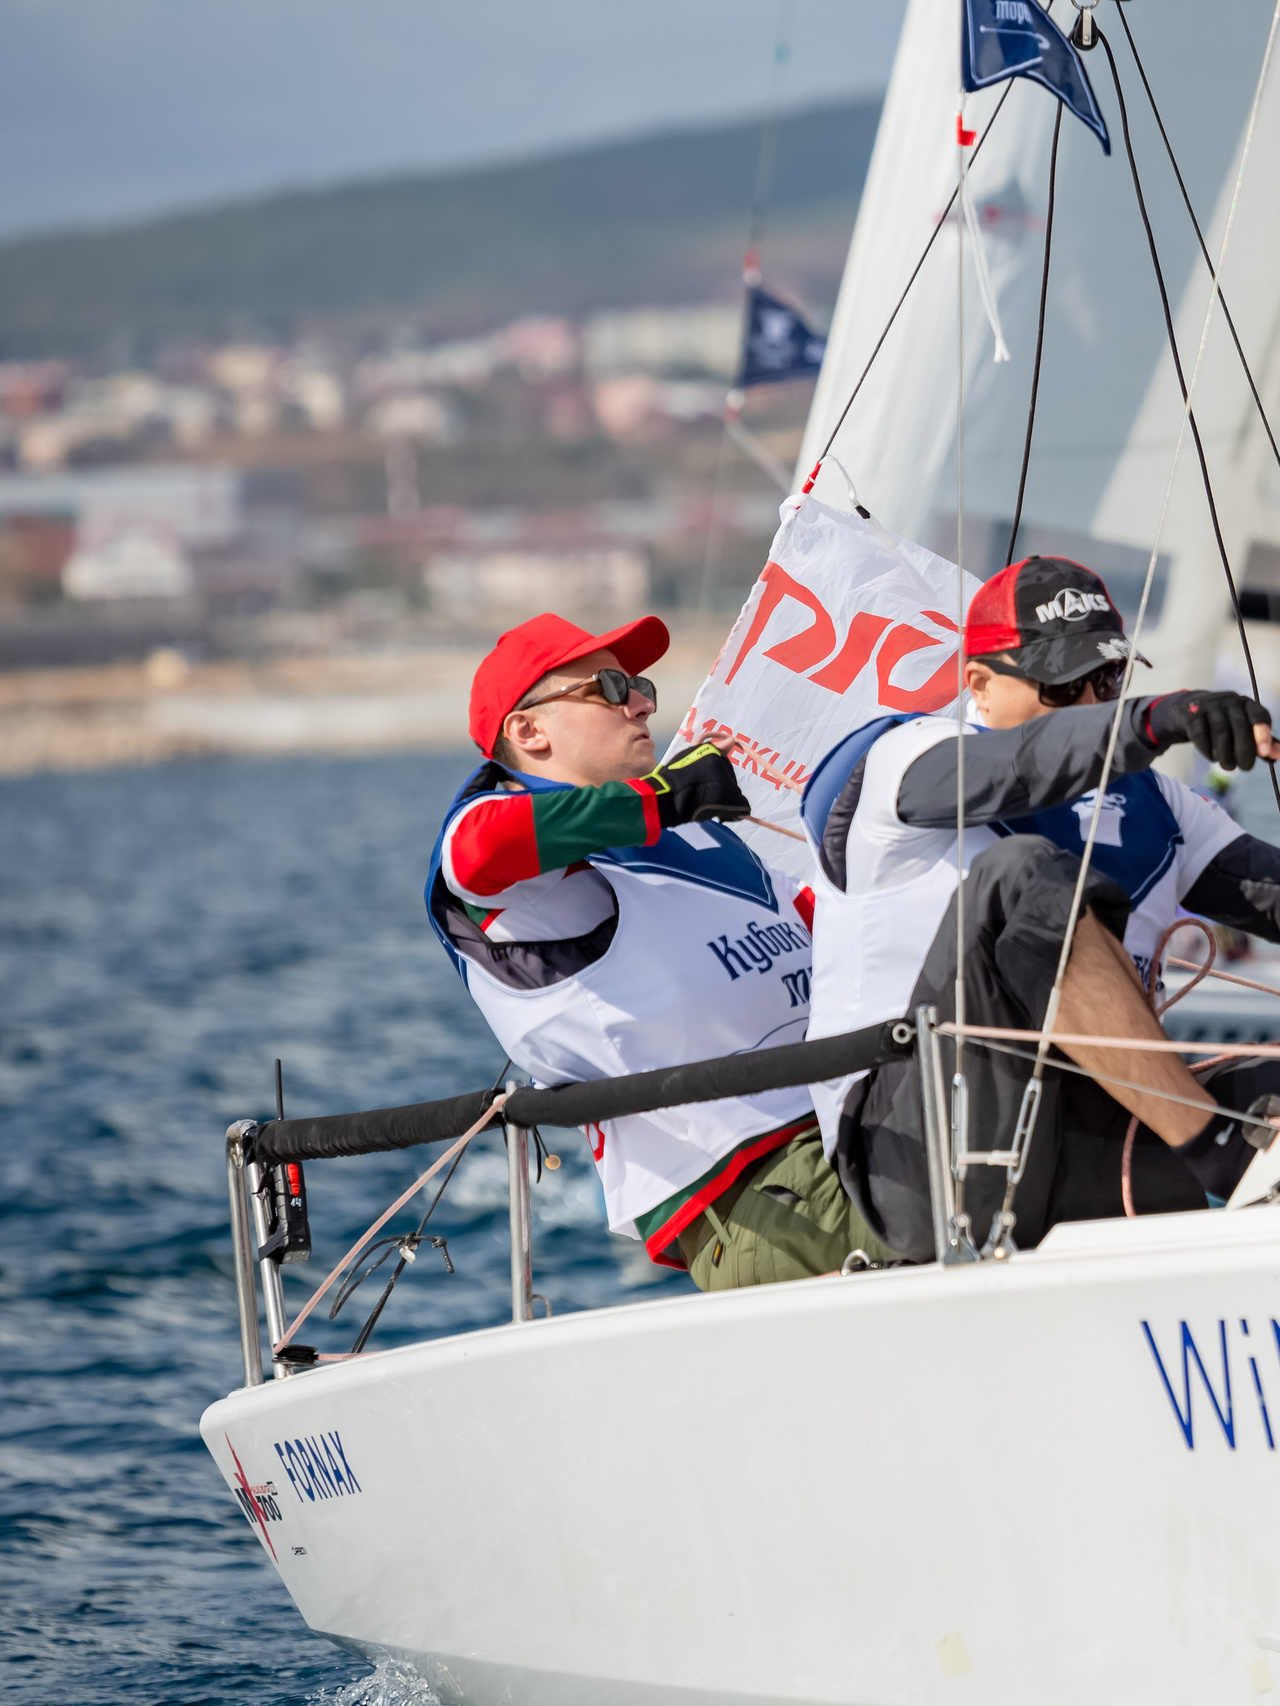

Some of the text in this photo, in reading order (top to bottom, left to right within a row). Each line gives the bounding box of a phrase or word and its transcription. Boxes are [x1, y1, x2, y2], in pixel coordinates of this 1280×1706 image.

[1035, 588, 1111, 624] MAKS
[706, 921, 809, 982] Кубок
[273, 1430, 363, 1503] FORNAX
